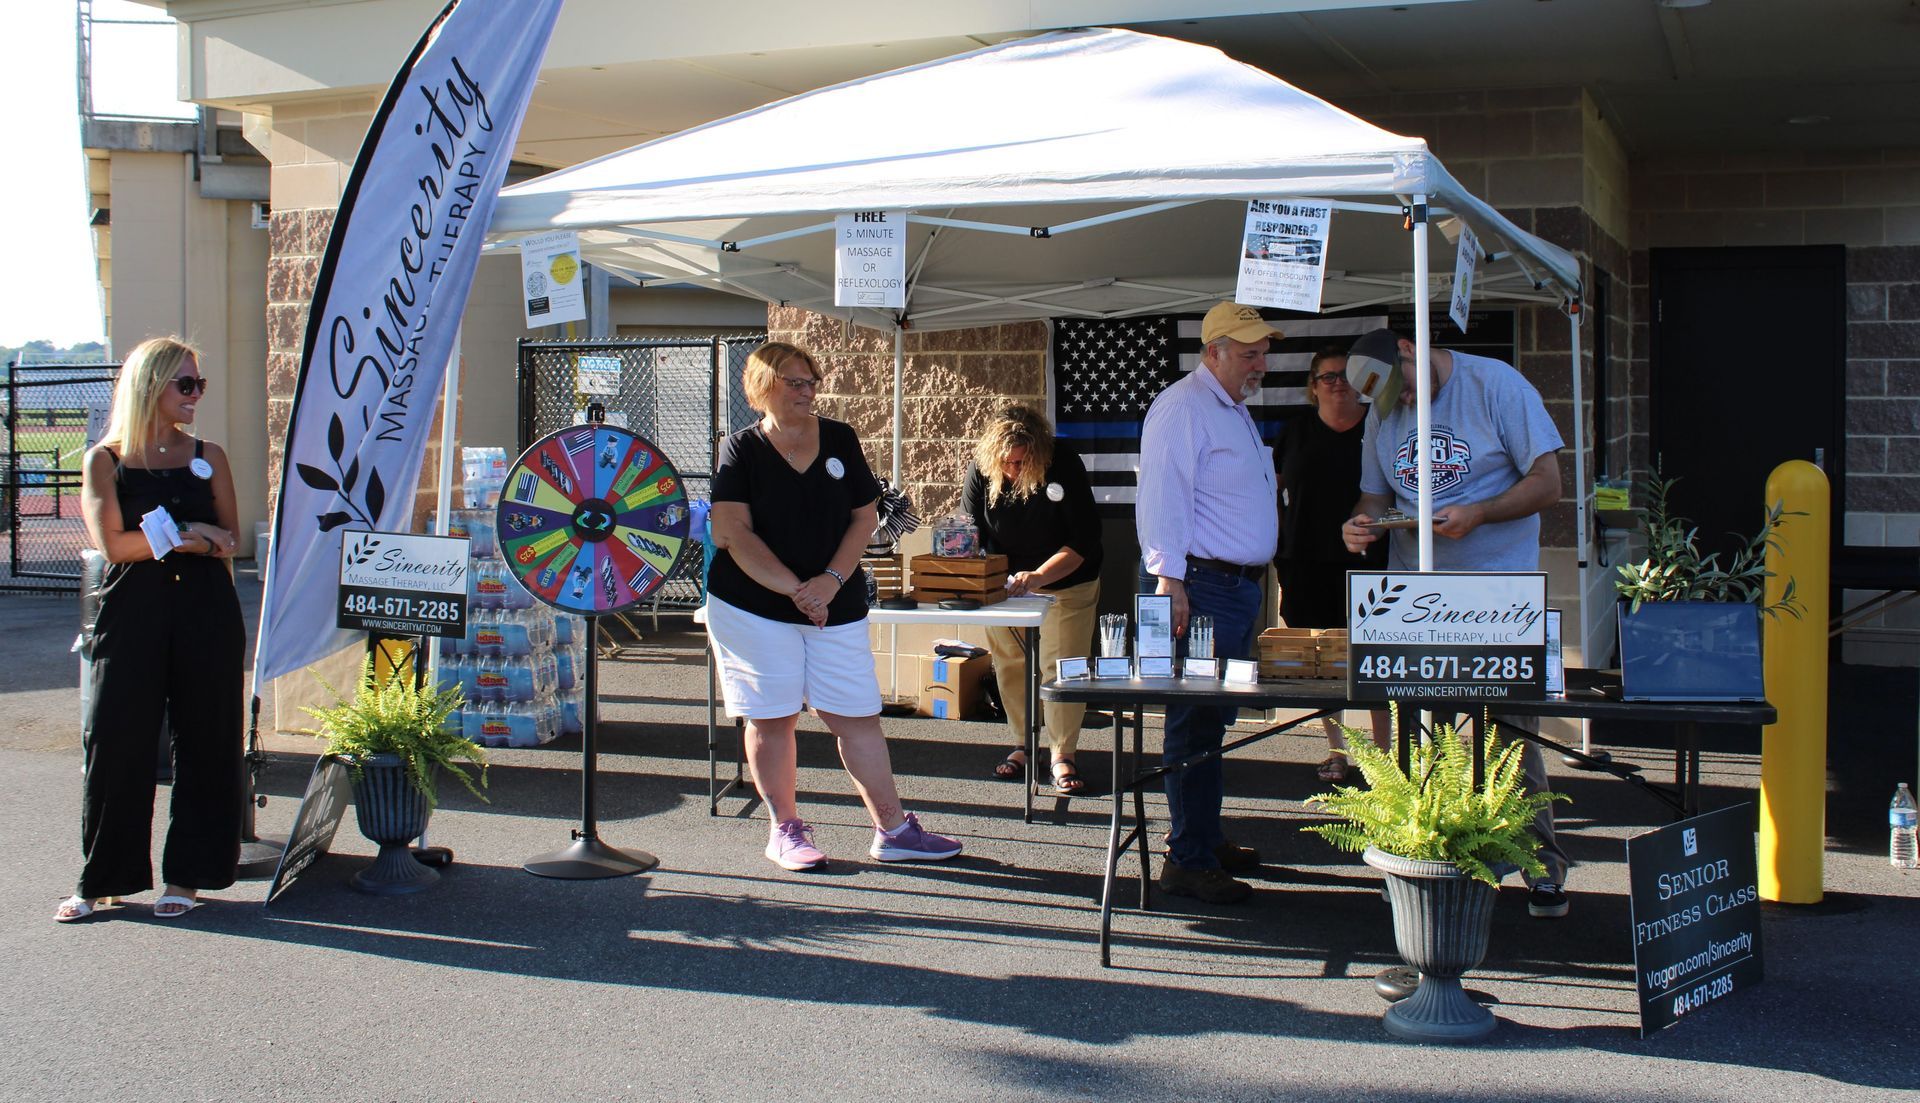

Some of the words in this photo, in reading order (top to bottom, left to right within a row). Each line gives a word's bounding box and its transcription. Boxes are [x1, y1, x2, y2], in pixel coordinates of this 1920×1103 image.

[854, 211, 887, 222] FREE
[1250, 199, 1270, 213] ARE
[1272, 204, 1290, 216] YOU
[1292, 206, 1298, 216] A
[1300, 206, 1328, 219] FIRST
[846, 228, 852, 238] 5
[856, 228, 894, 238] MINUTE
[1255, 220, 1318, 236] RESPONDER?
[329, 56, 494, 428] Sincerity
[847, 247, 893, 257] MASSAGE
[862, 262, 876, 272] OR
[1257, 269, 1278, 278] OFFER
[1279, 271, 1317, 282] DISCOUNTS
[838, 278, 903, 288] REFLEXOLOGY
[376, 294, 433, 441] MASSA
[660, 478, 674, 493] $25
[520, 547, 535, 562] $25
[375, 548, 467, 586] Sincerity
[348, 573, 389, 586] MASSAGE
[391, 576, 431, 590] THERAPY,
[432, 582, 447, 591] LLC
[540, 568, 552, 588] FREE
[344, 593, 459, 621] 484-671-2285
[1401, 592, 1543, 637] Sincerity
[361, 618, 442, 634] WWW.SINCERITYMT.COM
[1362, 628, 1424, 643] MASSAGE
[1428, 629, 1488, 645] THERAPY,
[1492, 632, 1513, 643] LLC
[1359, 654, 1534, 680] 484-671-2285
[1385, 686, 1508, 698] WWW.SINCERITYMT.COM
[1658, 858, 1730, 901] SENIOR
[1636, 905, 1701, 946] FITNESS
[1706, 884, 1757, 917] CLASS
[1646, 932, 1752, 990] Vagaro.com/Sincerity
[1672, 972, 1734, 1017] 484-671-2285
